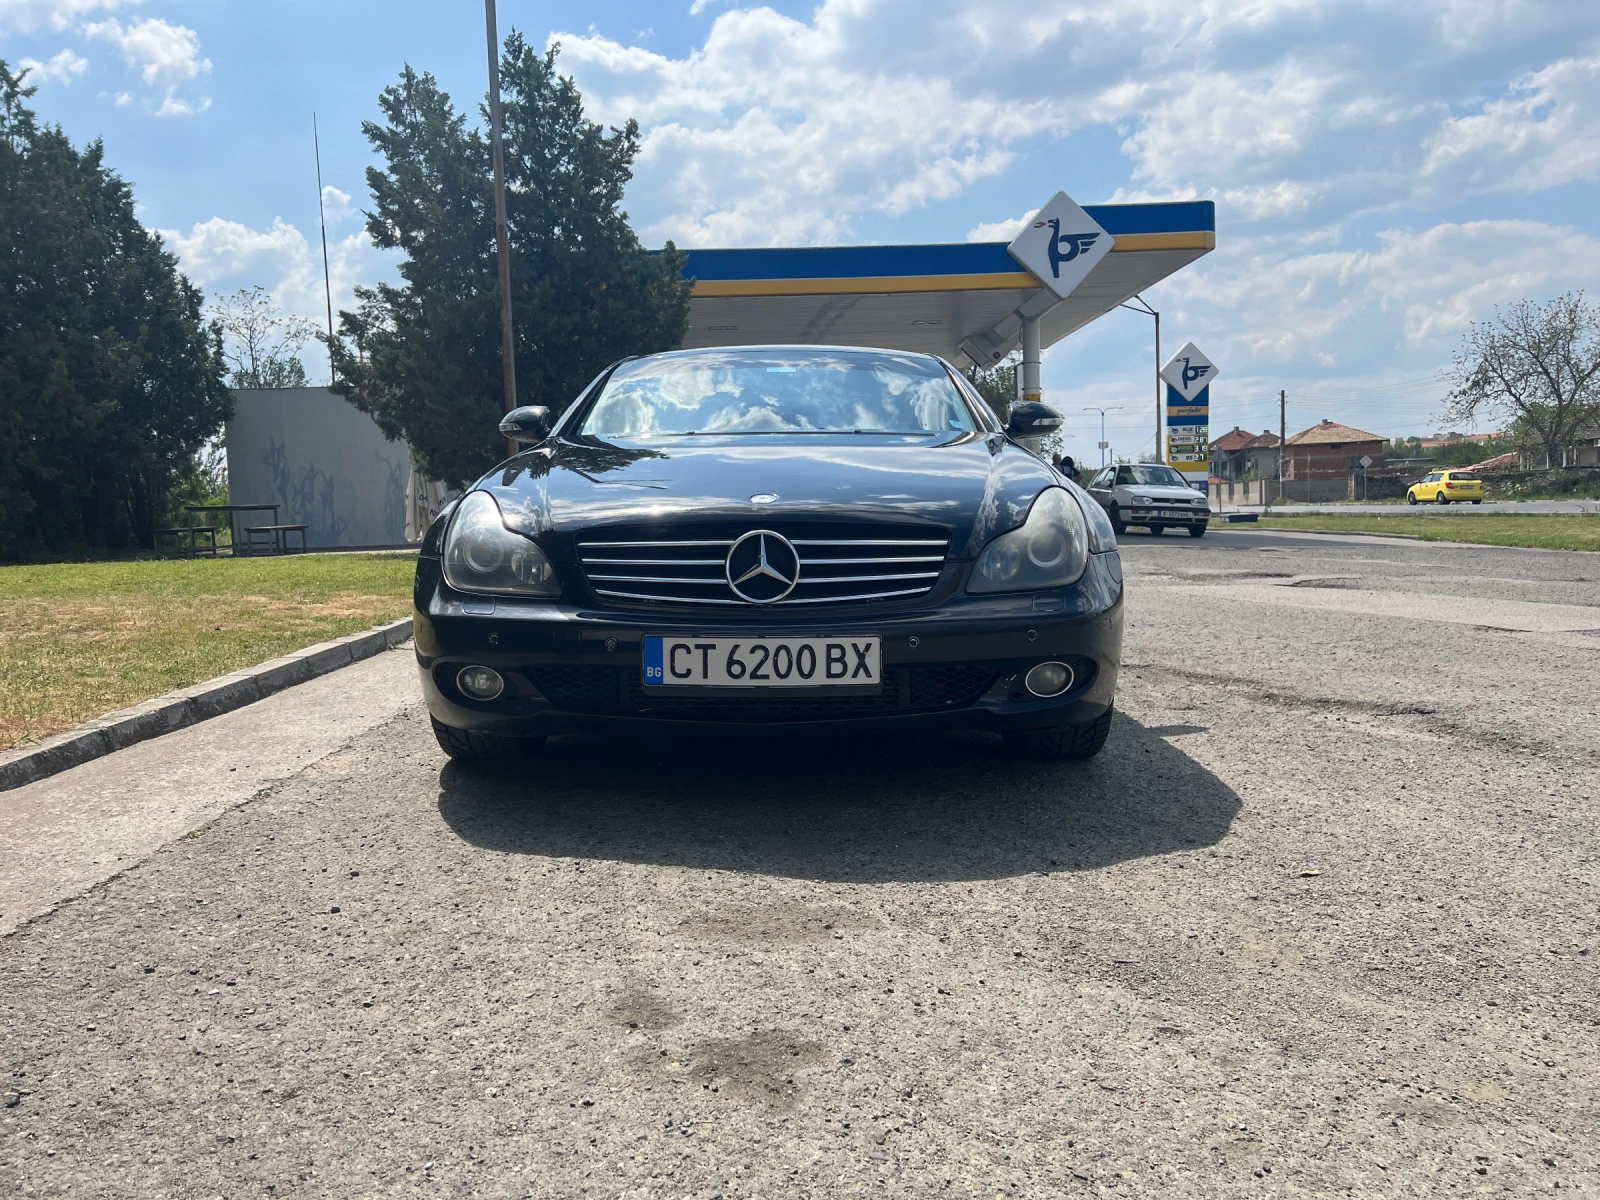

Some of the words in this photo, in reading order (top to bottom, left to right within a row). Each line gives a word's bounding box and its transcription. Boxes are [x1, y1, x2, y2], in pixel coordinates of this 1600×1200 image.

[646, 667, 662, 678] BG
[670, 643, 717, 680] CT
[726, 643, 817, 680] 6200
[826, 642, 873, 679] BX
